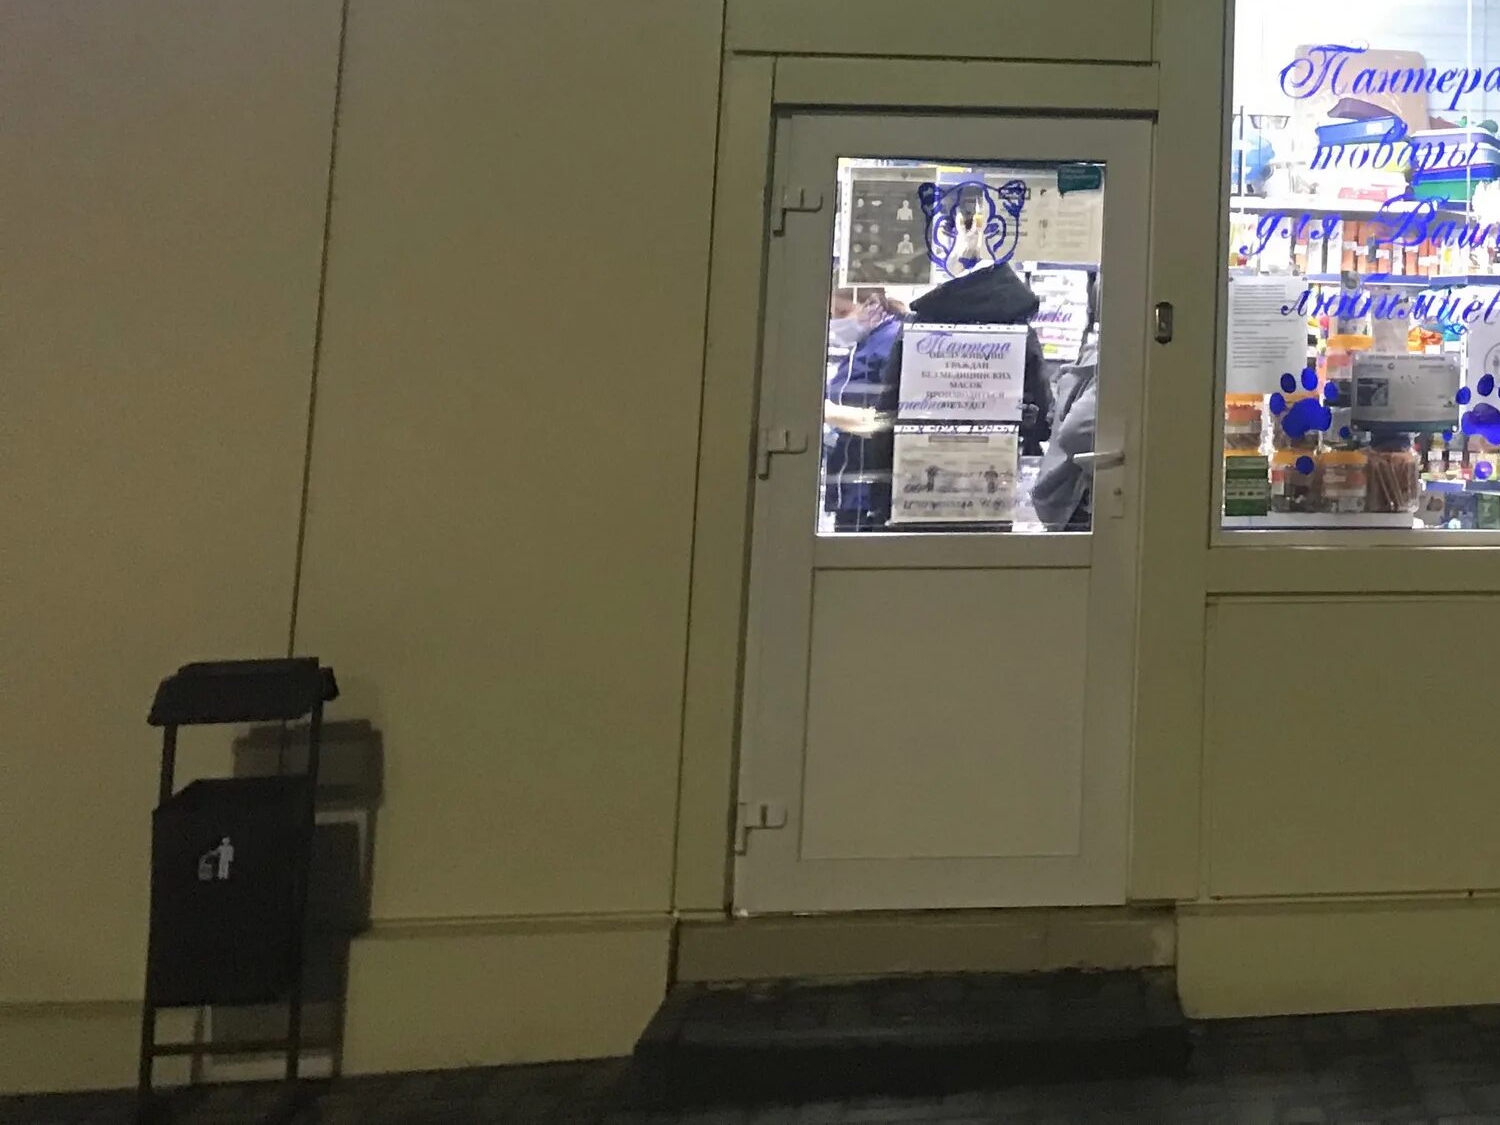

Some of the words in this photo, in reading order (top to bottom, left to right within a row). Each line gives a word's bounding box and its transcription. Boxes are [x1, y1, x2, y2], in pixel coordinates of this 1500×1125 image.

[1309, 122, 1479, 187] товары
[1239, 211, 1344, 256] для
[916, 330, 1012, 360] Пантера
